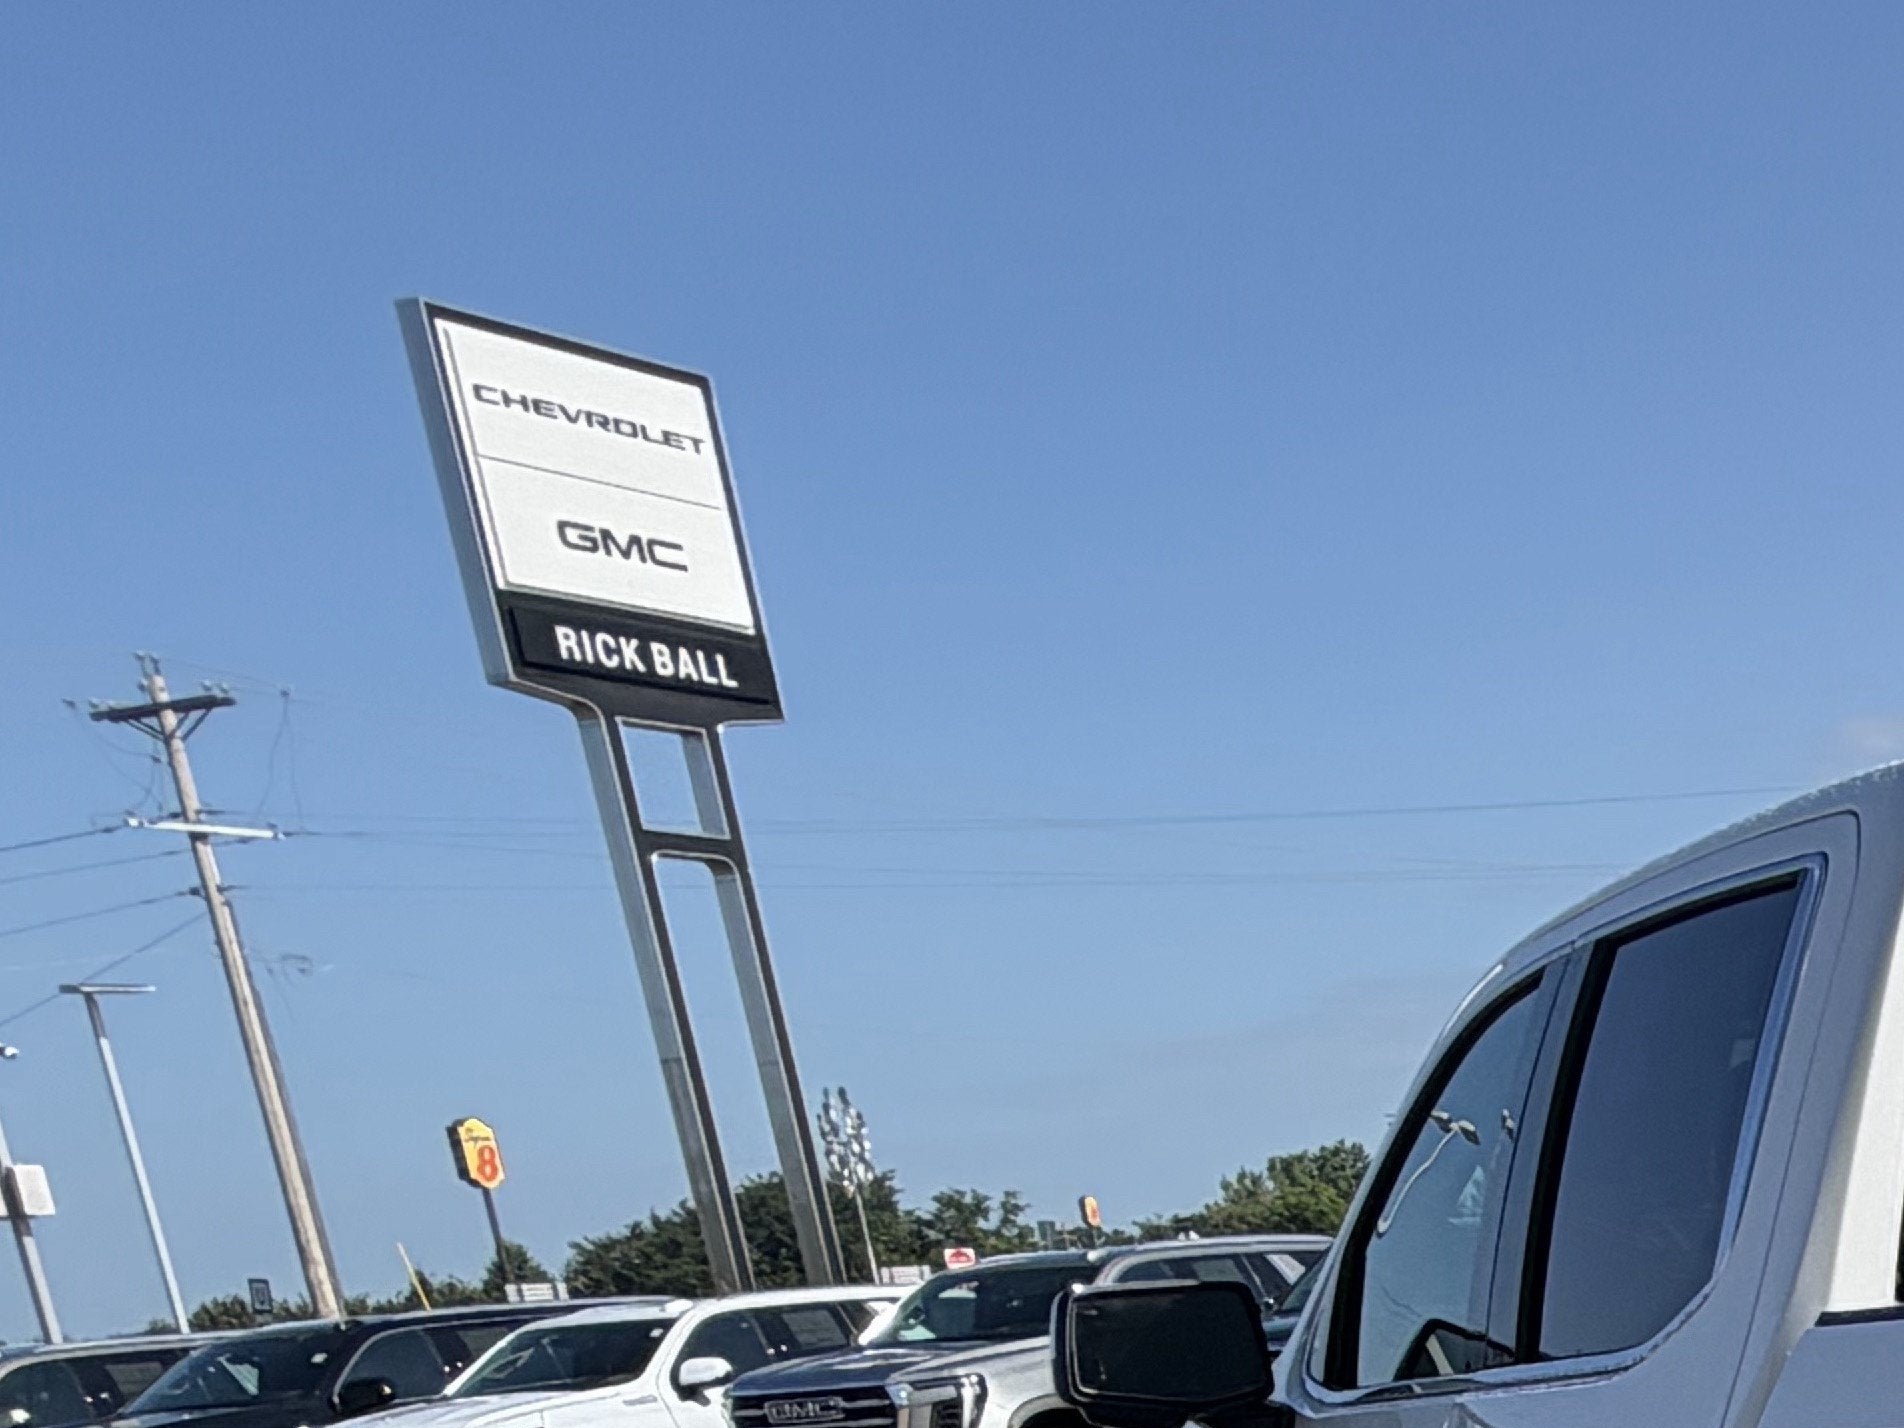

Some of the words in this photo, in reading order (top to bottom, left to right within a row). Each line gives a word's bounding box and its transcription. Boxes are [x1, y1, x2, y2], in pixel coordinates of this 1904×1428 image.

[472, 383, 706, 454] CHEVROLET
[556, 519, 688, 572] GMC
[554, 624, 646, 674] RICK
[649, 640, 739, 689] BALL
[477, 1144, 498, 1182] 8
